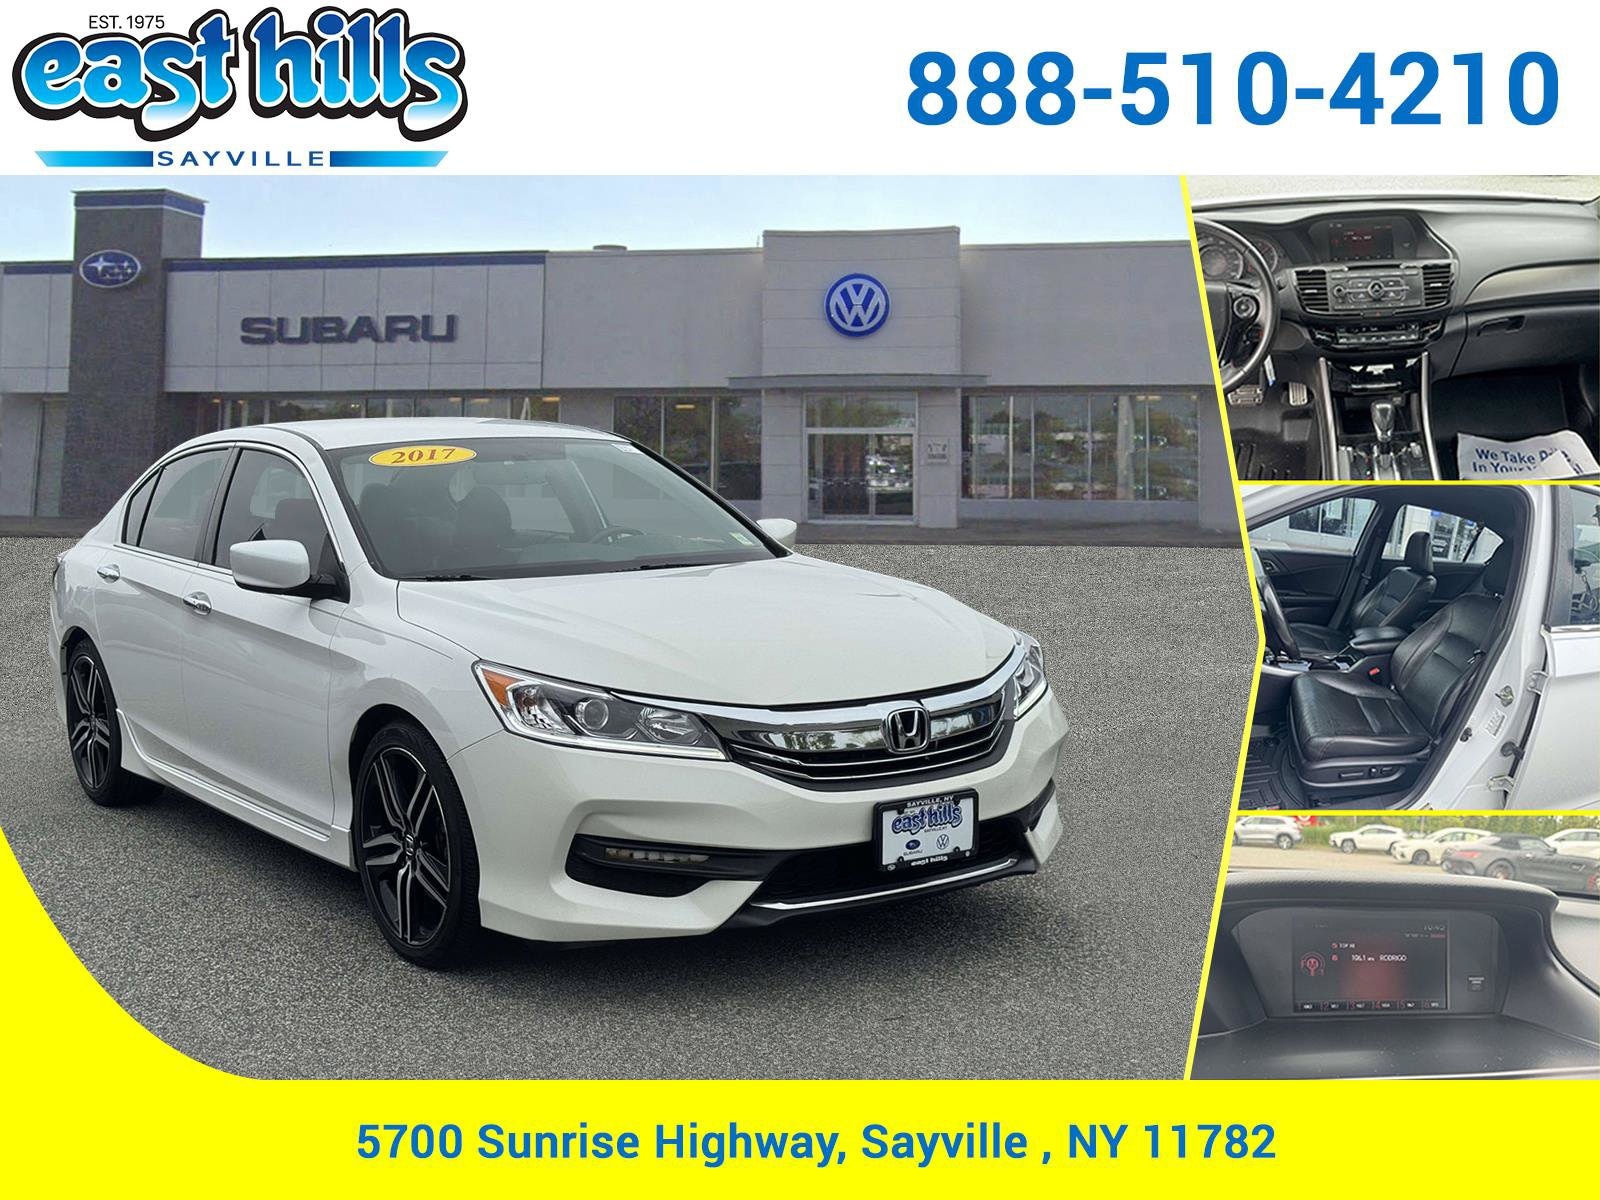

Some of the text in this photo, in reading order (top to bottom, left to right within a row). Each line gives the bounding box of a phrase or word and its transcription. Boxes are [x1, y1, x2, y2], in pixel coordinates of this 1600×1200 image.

[240, 314, 459, 345] SUBARU
[391, 448, 456, 464] 2017
[1475, 448, 1498, 460] We
[1501, 450, 1536, 465] Take
[892, 802, 963, 835] east hills
